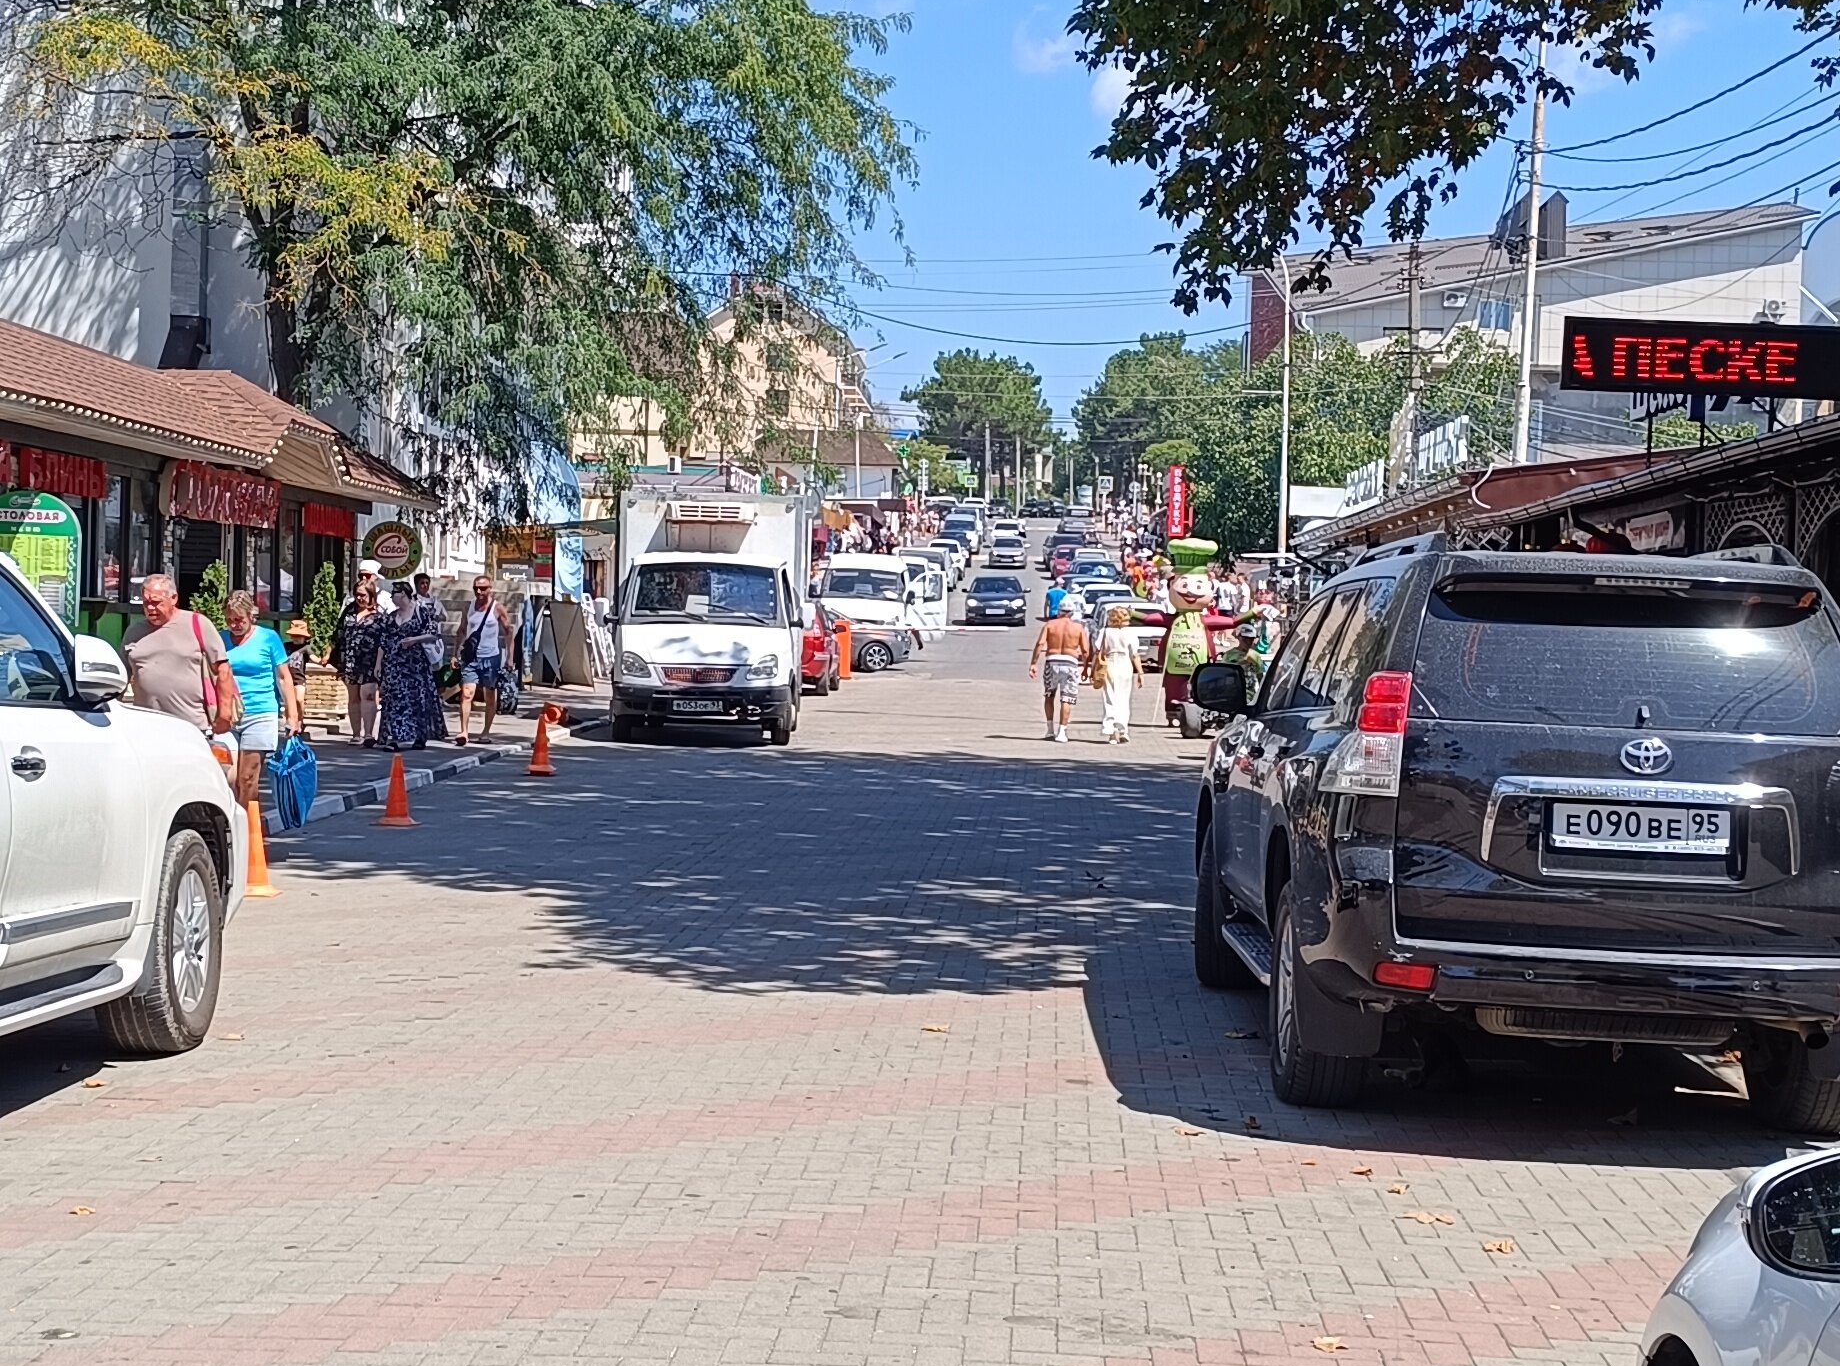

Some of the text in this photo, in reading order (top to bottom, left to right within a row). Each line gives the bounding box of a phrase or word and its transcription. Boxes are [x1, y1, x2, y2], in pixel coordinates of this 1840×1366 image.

[1612, 337, 1797, 382] ПЕСКЕ
[30, 451, 107, 499] БЛИНЫ
[1171, 468, 1183, 533] ПРОДУКТЫ
[1557, 783, 1601, 796] LAND
[1607, 785, 1678, 800] CRUISER
[1692, 813, 1720, 834] 95
[1695, 835, 1717, 844] RUS
